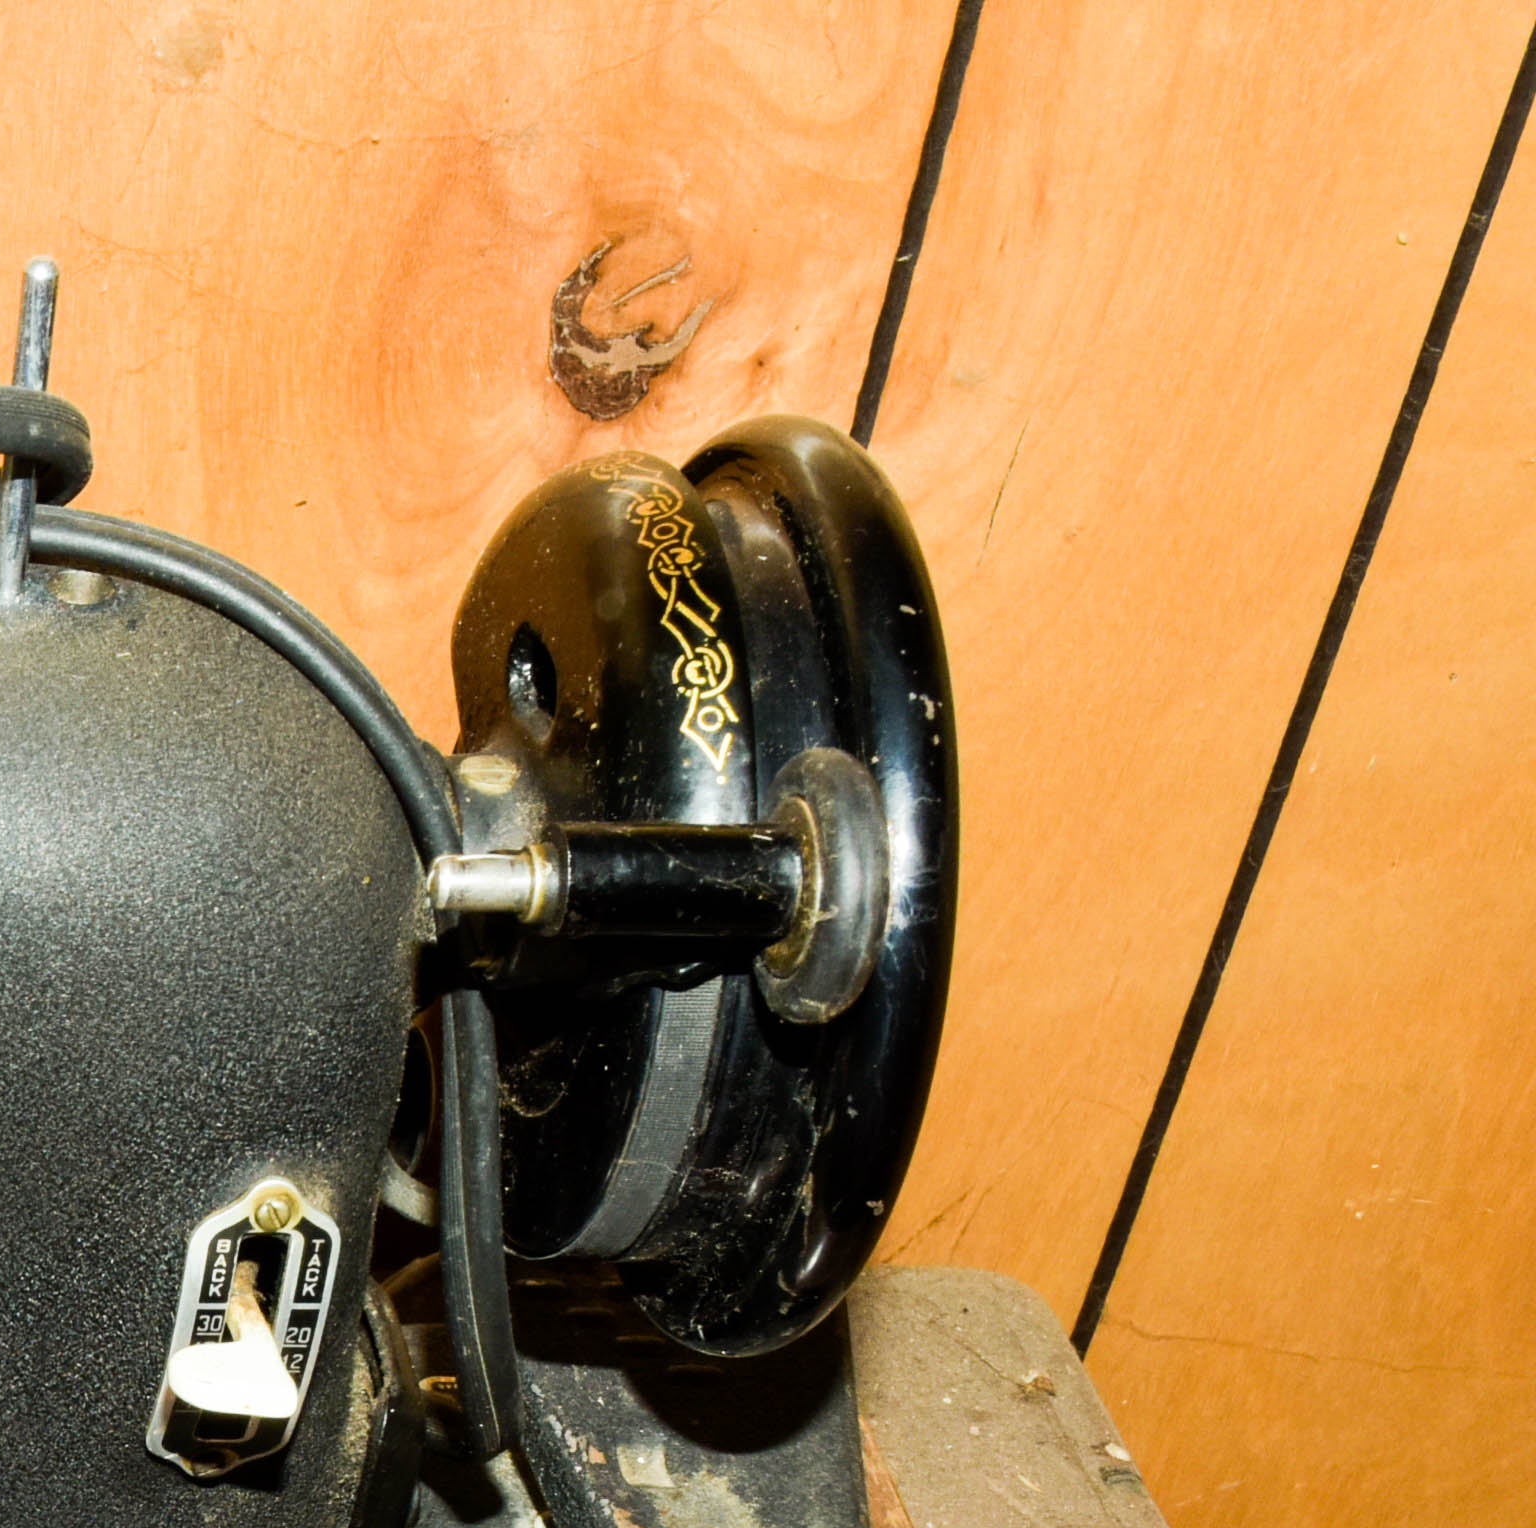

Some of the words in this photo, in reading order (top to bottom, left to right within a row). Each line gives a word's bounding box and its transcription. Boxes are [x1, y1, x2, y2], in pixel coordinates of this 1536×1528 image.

[208, 1238, 231, 1297] BACK
[301, 1238, 325, 1297] TACK
[196, 1314, 223, 1332] 30
[285, 1327, 311, 1344] 20
